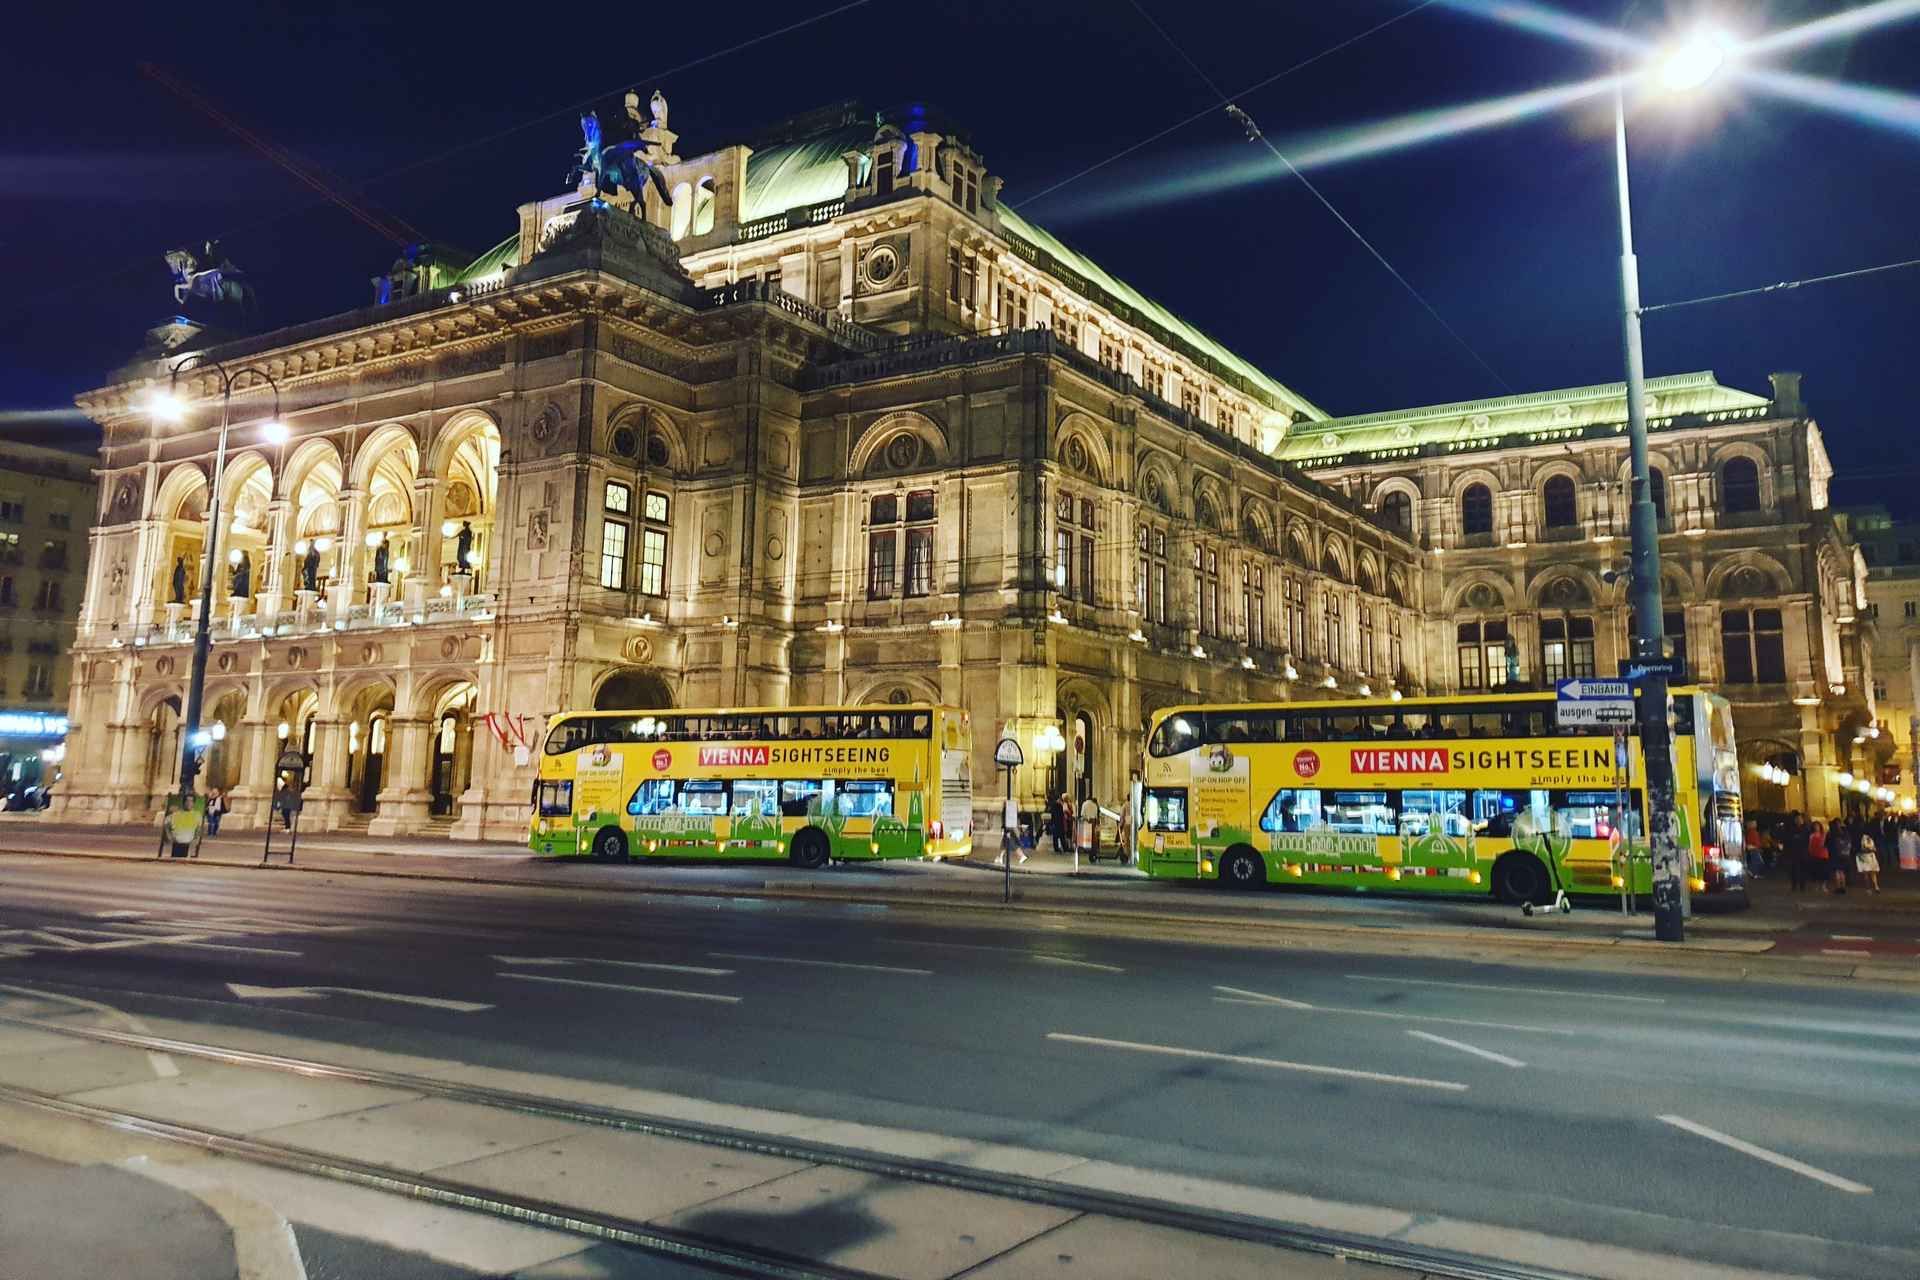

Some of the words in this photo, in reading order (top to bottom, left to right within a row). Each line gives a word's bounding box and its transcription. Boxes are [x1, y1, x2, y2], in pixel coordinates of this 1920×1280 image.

[1581, 683, 1625, 696] EINBAHN
[702, 748, 766, 765] VIENNA
[772, 747, 890, 764] SIGHTSEEING
[1353, 751, 1444, 771] VIENNA
[1453, 750, 1611, 769] SIGHTSEEIN
[1531, 775, 1572, 785] simply
